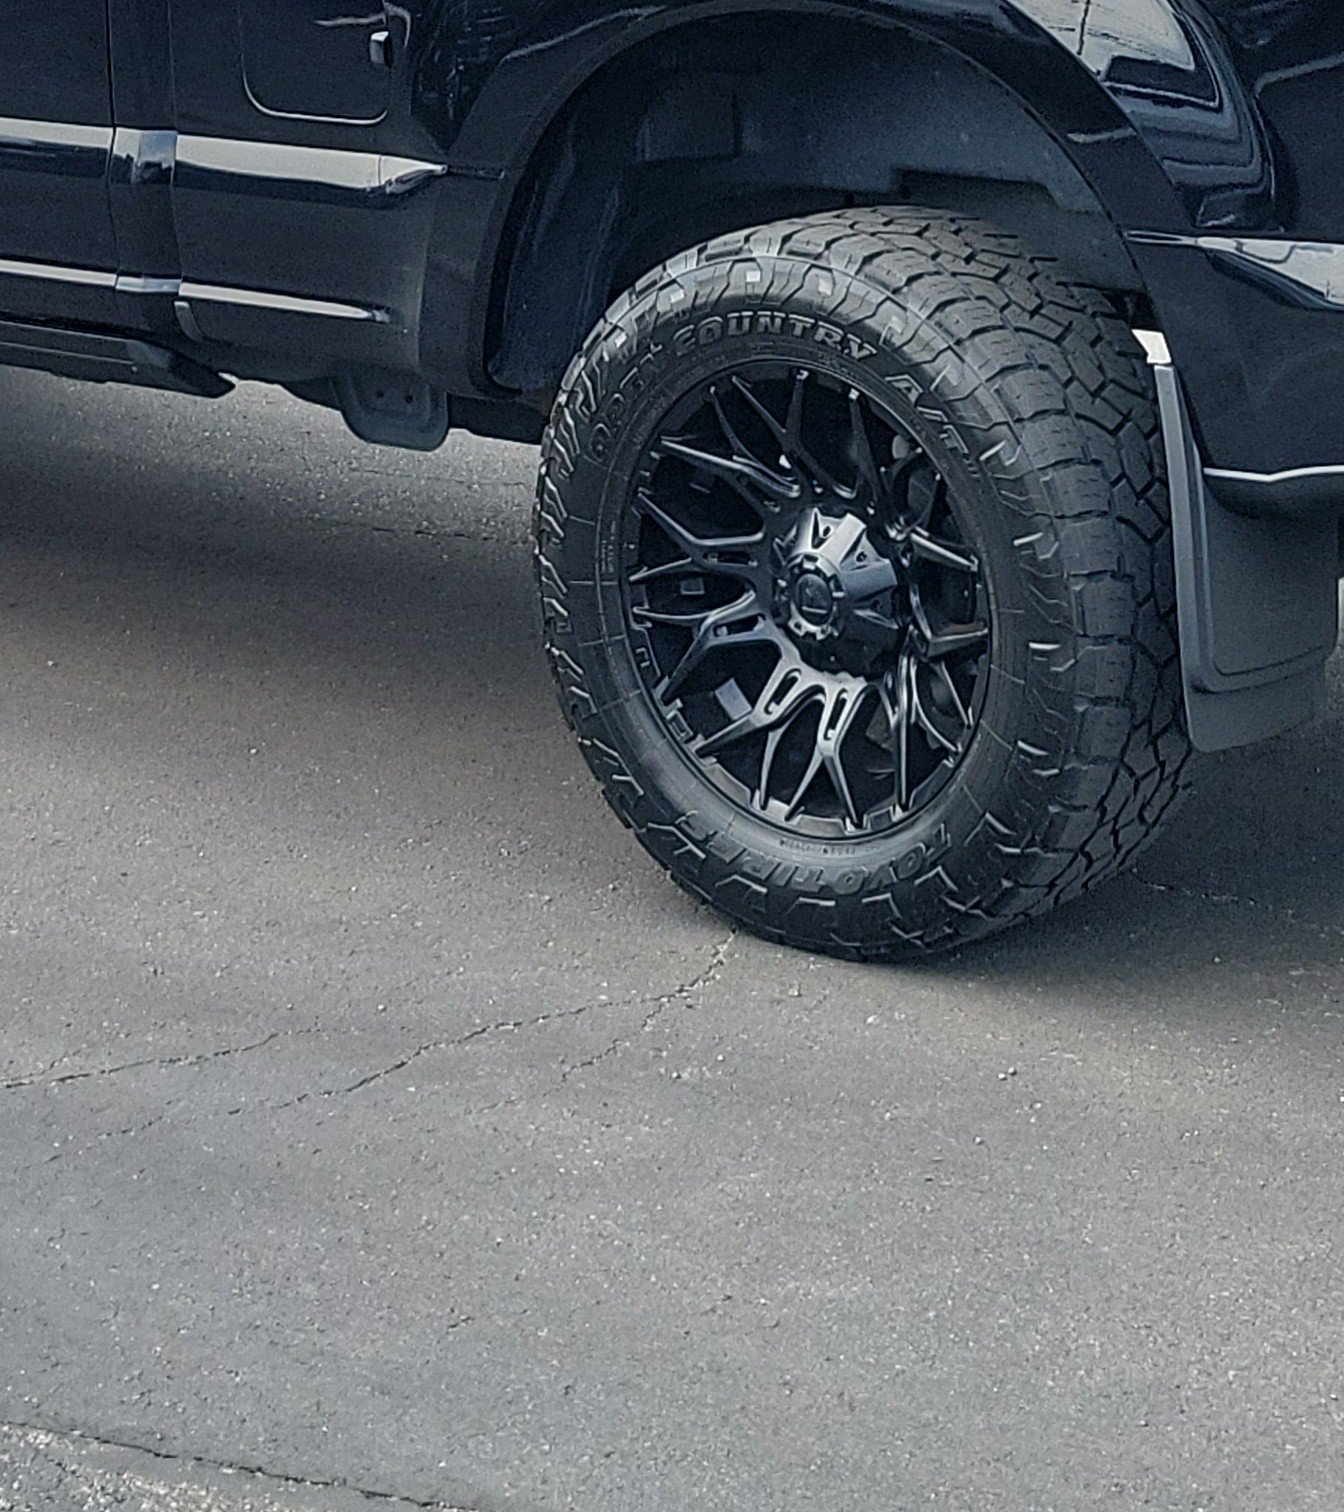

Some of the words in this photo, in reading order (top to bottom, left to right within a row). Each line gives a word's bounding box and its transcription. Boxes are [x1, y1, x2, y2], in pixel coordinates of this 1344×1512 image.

[673, 310, 878, 362] COUNTRY
[884, 373, 970, 458] A/T
[832, 822, 953, 896] TOYO
